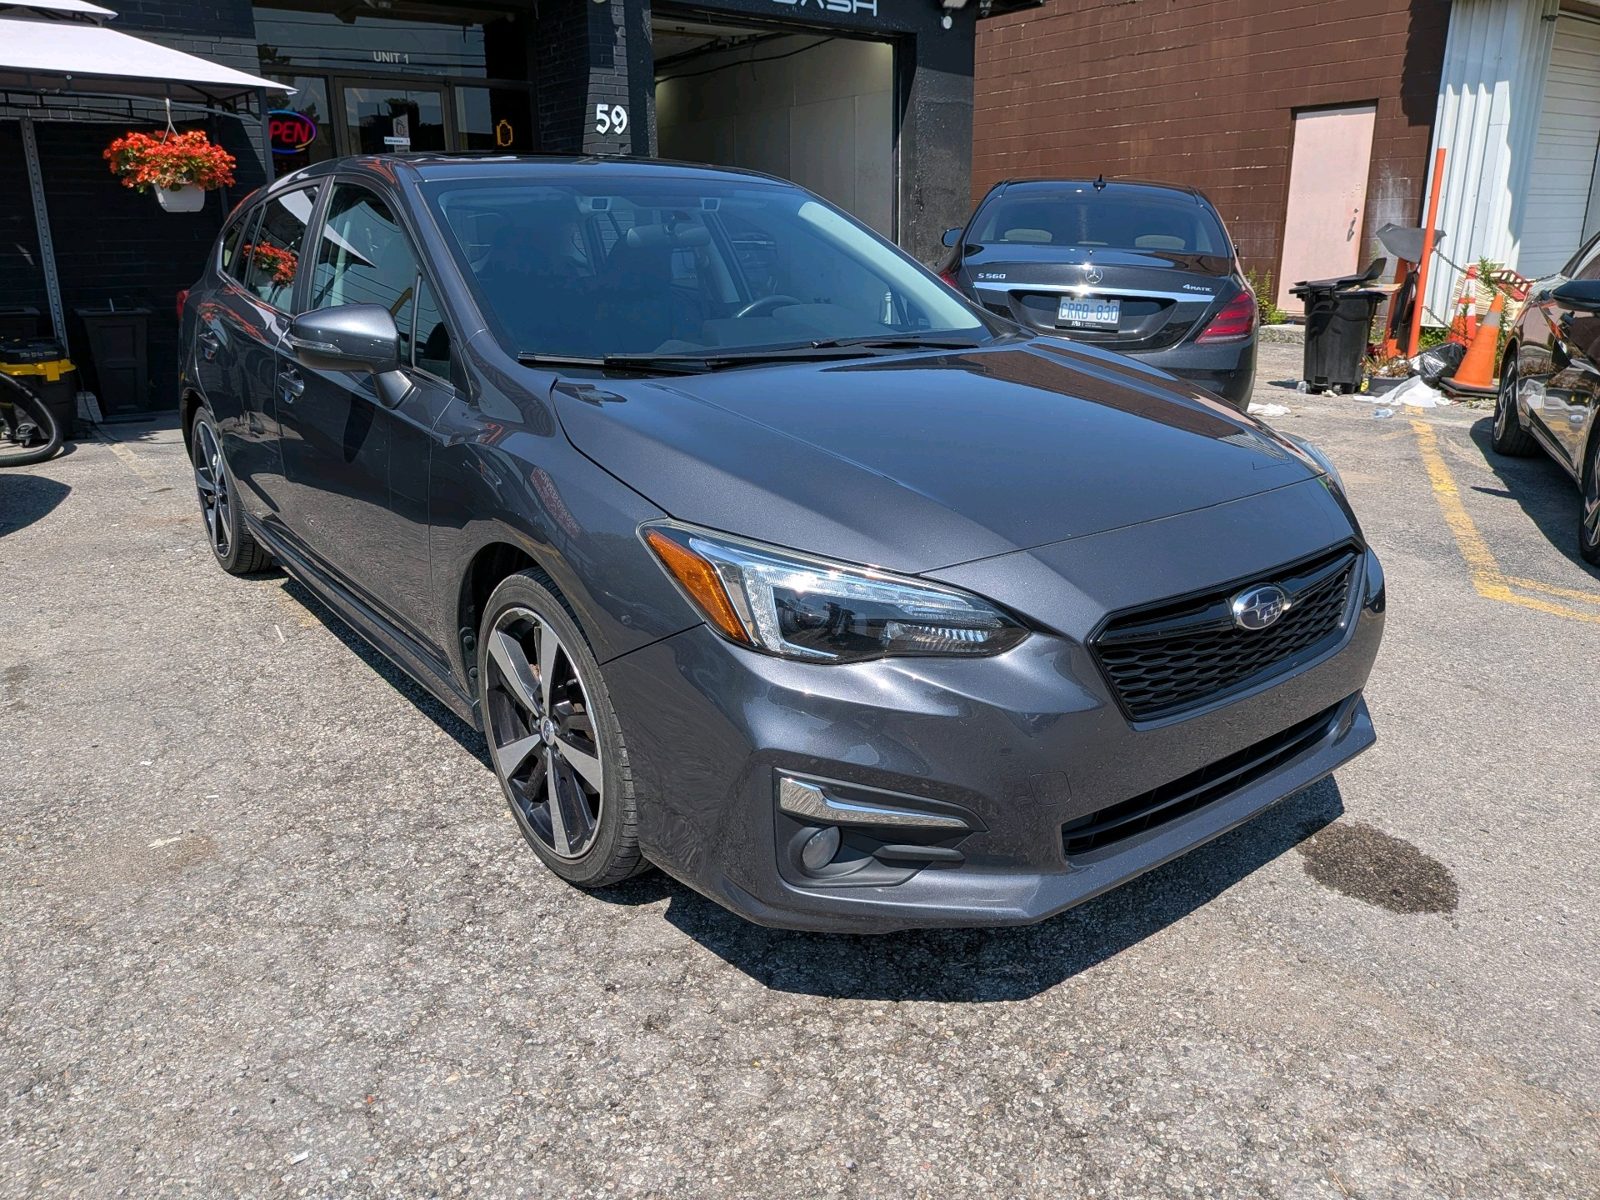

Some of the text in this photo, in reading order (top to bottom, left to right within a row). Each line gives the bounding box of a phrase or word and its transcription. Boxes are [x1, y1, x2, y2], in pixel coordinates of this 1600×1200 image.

[373, 51, 409, 64] UNIT 1
[595, 103, 628, 135] 59
[268, 121, 310, 143] PEN
